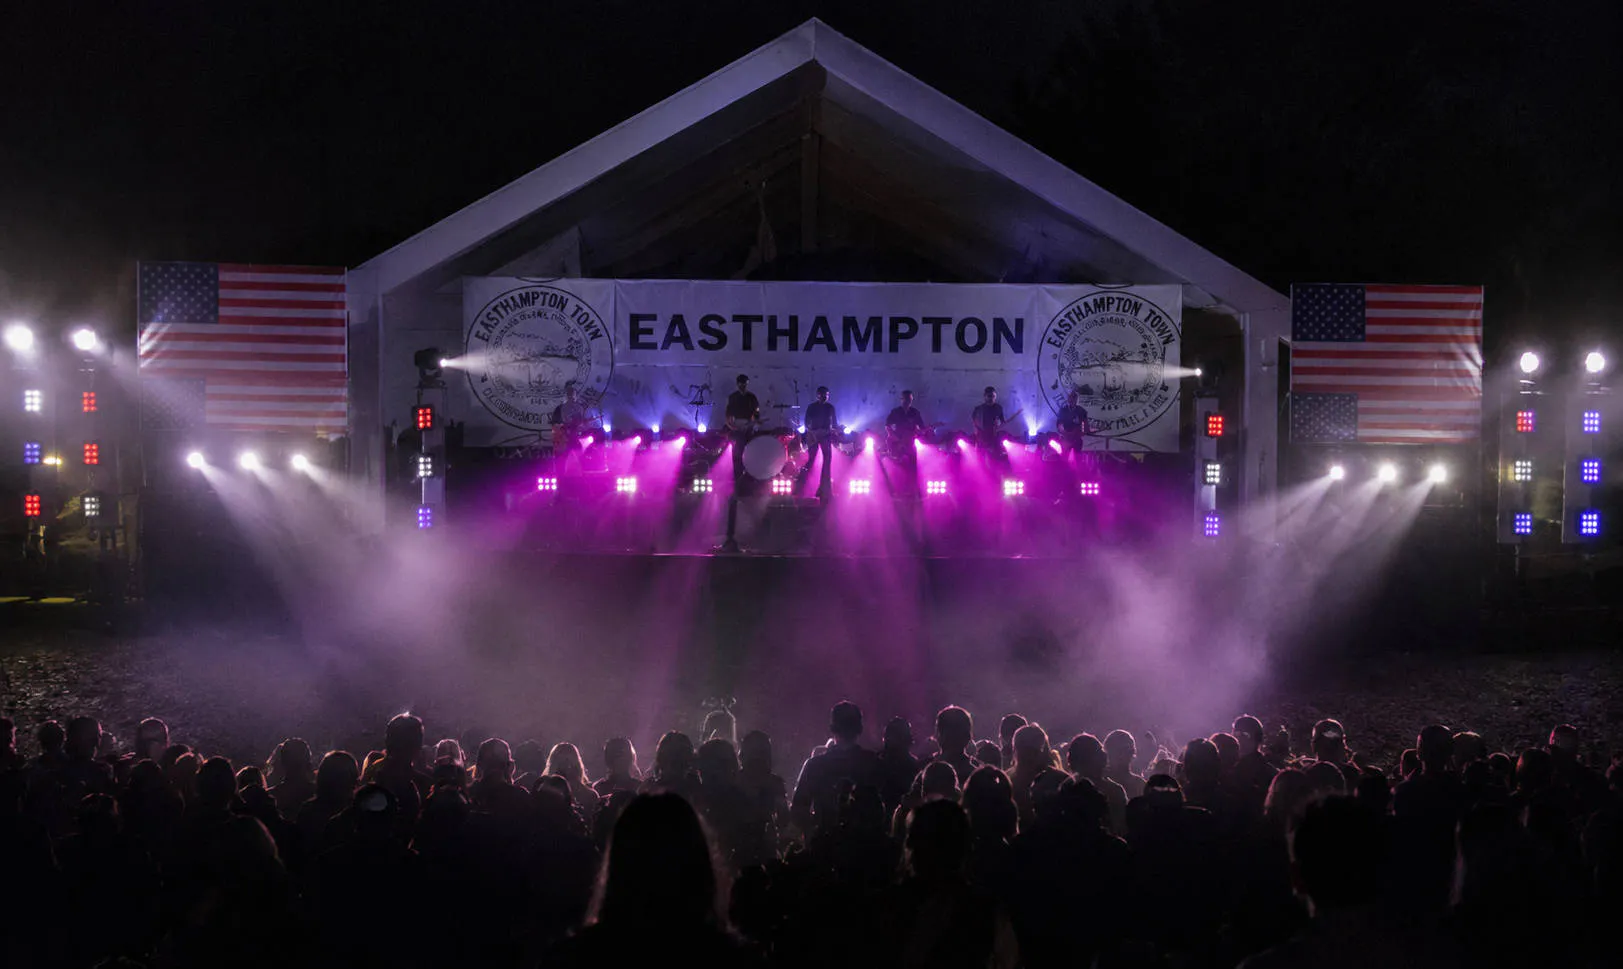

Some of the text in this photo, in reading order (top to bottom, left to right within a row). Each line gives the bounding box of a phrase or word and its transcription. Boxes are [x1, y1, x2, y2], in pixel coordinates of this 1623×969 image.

[474, 291, 569, 343] EASTHAMPTON
[570, 304, 603, 341] TOWN
[629, 313, 1024, 354] EASTHAMPTON
[1047, 296, 1143, 348] EASTHAMPTON
[1144, 308, 1176, 347] TOWN
